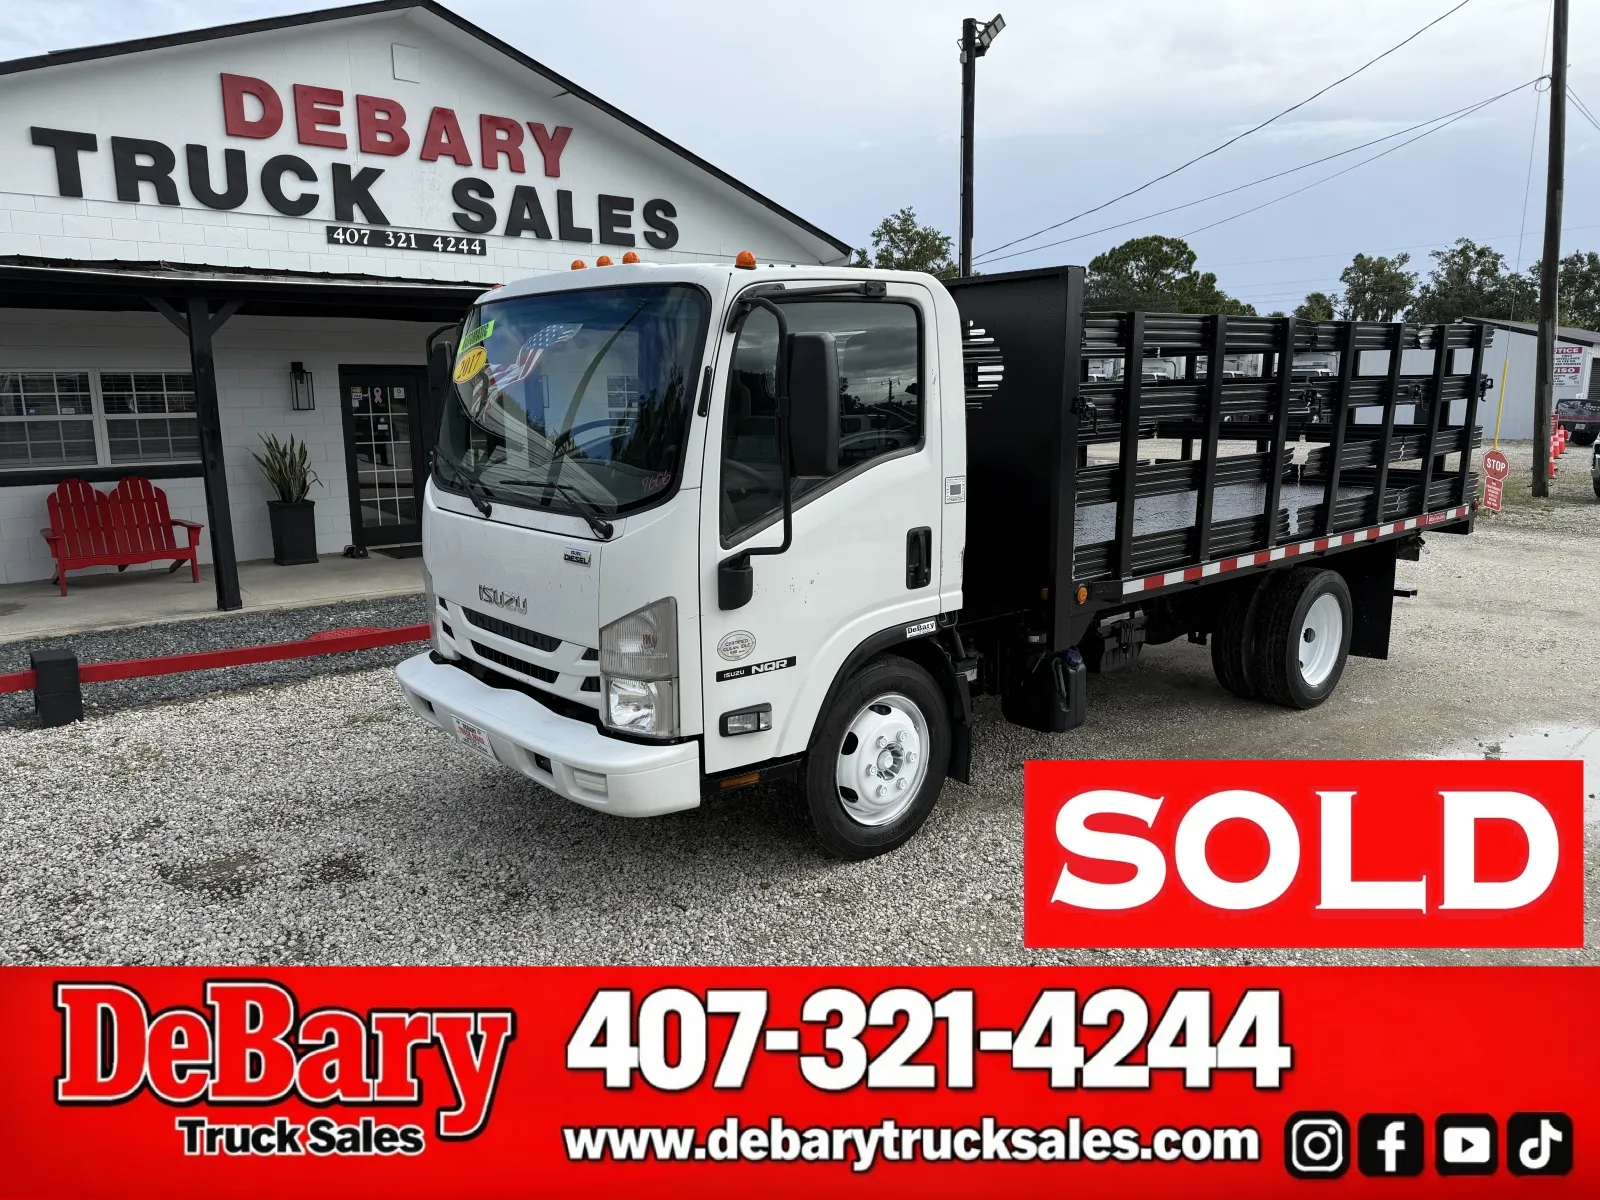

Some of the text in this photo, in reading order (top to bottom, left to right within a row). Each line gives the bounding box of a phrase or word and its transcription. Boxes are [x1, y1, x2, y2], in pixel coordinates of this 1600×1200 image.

[220, 72, 573, 178] DEBARY
[30, 126, 680, 249] TRUCK SALES
[333, 227, 482, 255] 407 321 4244
[456, 350, 483, 380] 2017
[1486, 458, 1506, 472] STOP
[564, 554, 589, 565] DIESEL
[478, 584, 528, 615] ISUZU
[908, 622, 935, 634] DeBary
[723, 659, 788, 679] ISUZU NQR
